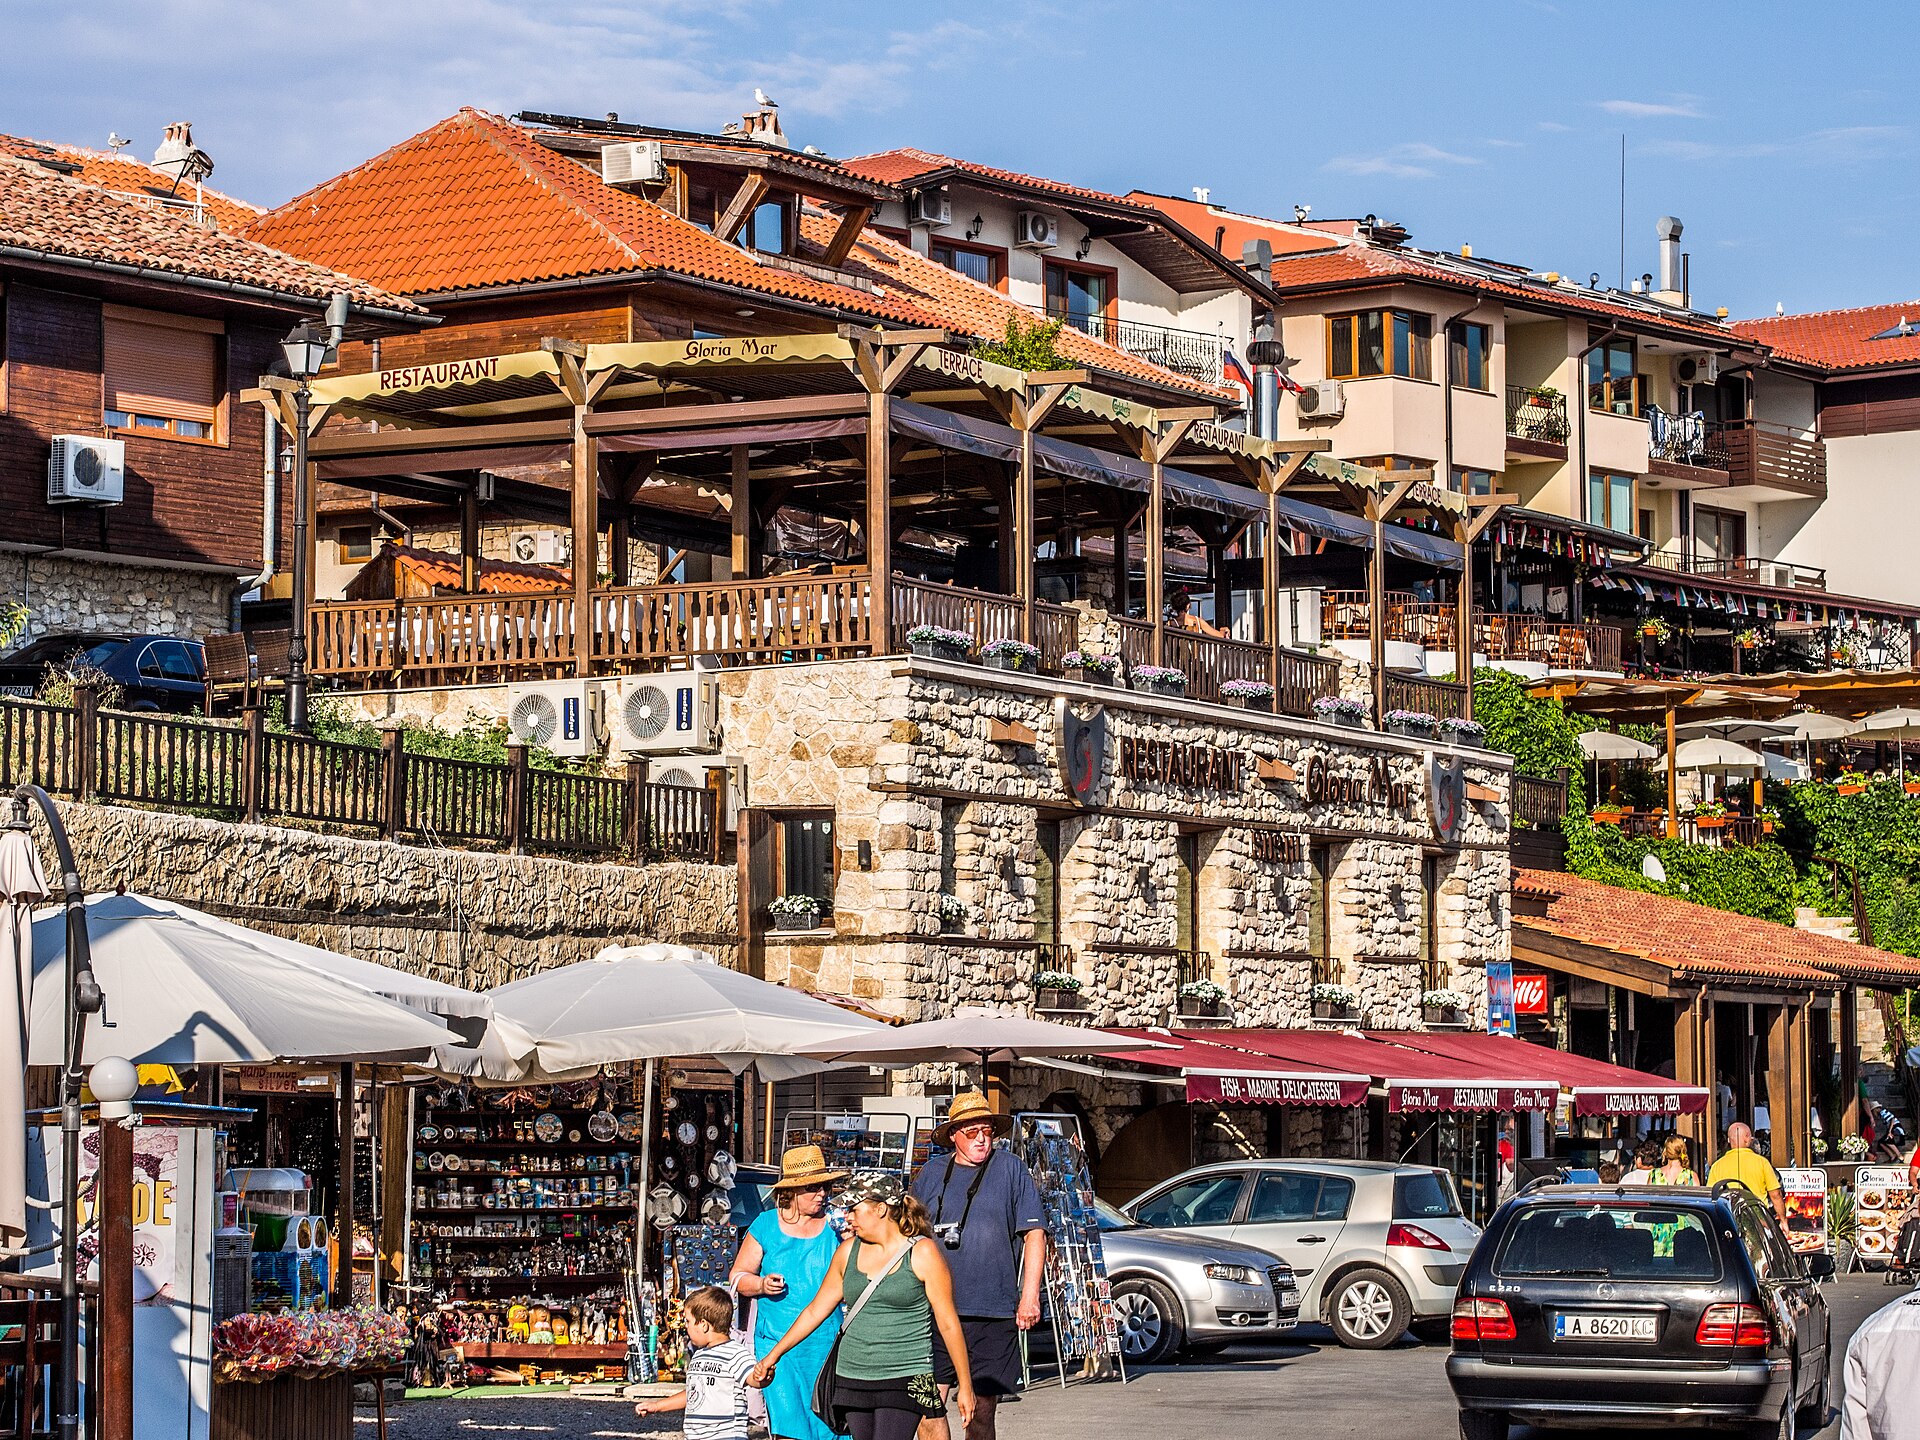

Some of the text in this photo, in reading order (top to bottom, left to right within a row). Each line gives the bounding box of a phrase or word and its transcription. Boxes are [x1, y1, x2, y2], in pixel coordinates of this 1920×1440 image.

[682, 339, 777, 360] Gloria Mar
[380, 357, 499, 390] RESTAURANT
[938, 348, 983, 379] TERRACE
[1193, 422, 1245, 451] RESTAURANT
[1119, 735, 1411, 808] RESTAURANT Gloria Mar
[1513, 980, 1543, 1009] illy
[1220, 1077, 1240, 1097] FISH
[1246, 1078, 1280, 1099] MARINE
[1282, 1079, 1340, 1100] DELICATESSEN
[1401, 1087, 1549, 1107] Gloria Mar RESTAURANT Gloria Mar
[1605, 1094, 1633, 1111] LAZZANIA
[1641, 1095, 1659, 1111] PASTA
[1664, 1095, 1680, 1111] PIZZA
[1801, 1174, 1822, 1183] Mar
[1860, 1171, 1908, 1184] Gloria Ma
[1571, 1318, 1654, 1336] A 8620 KC
[706, 1376, 716, 1386] 30
